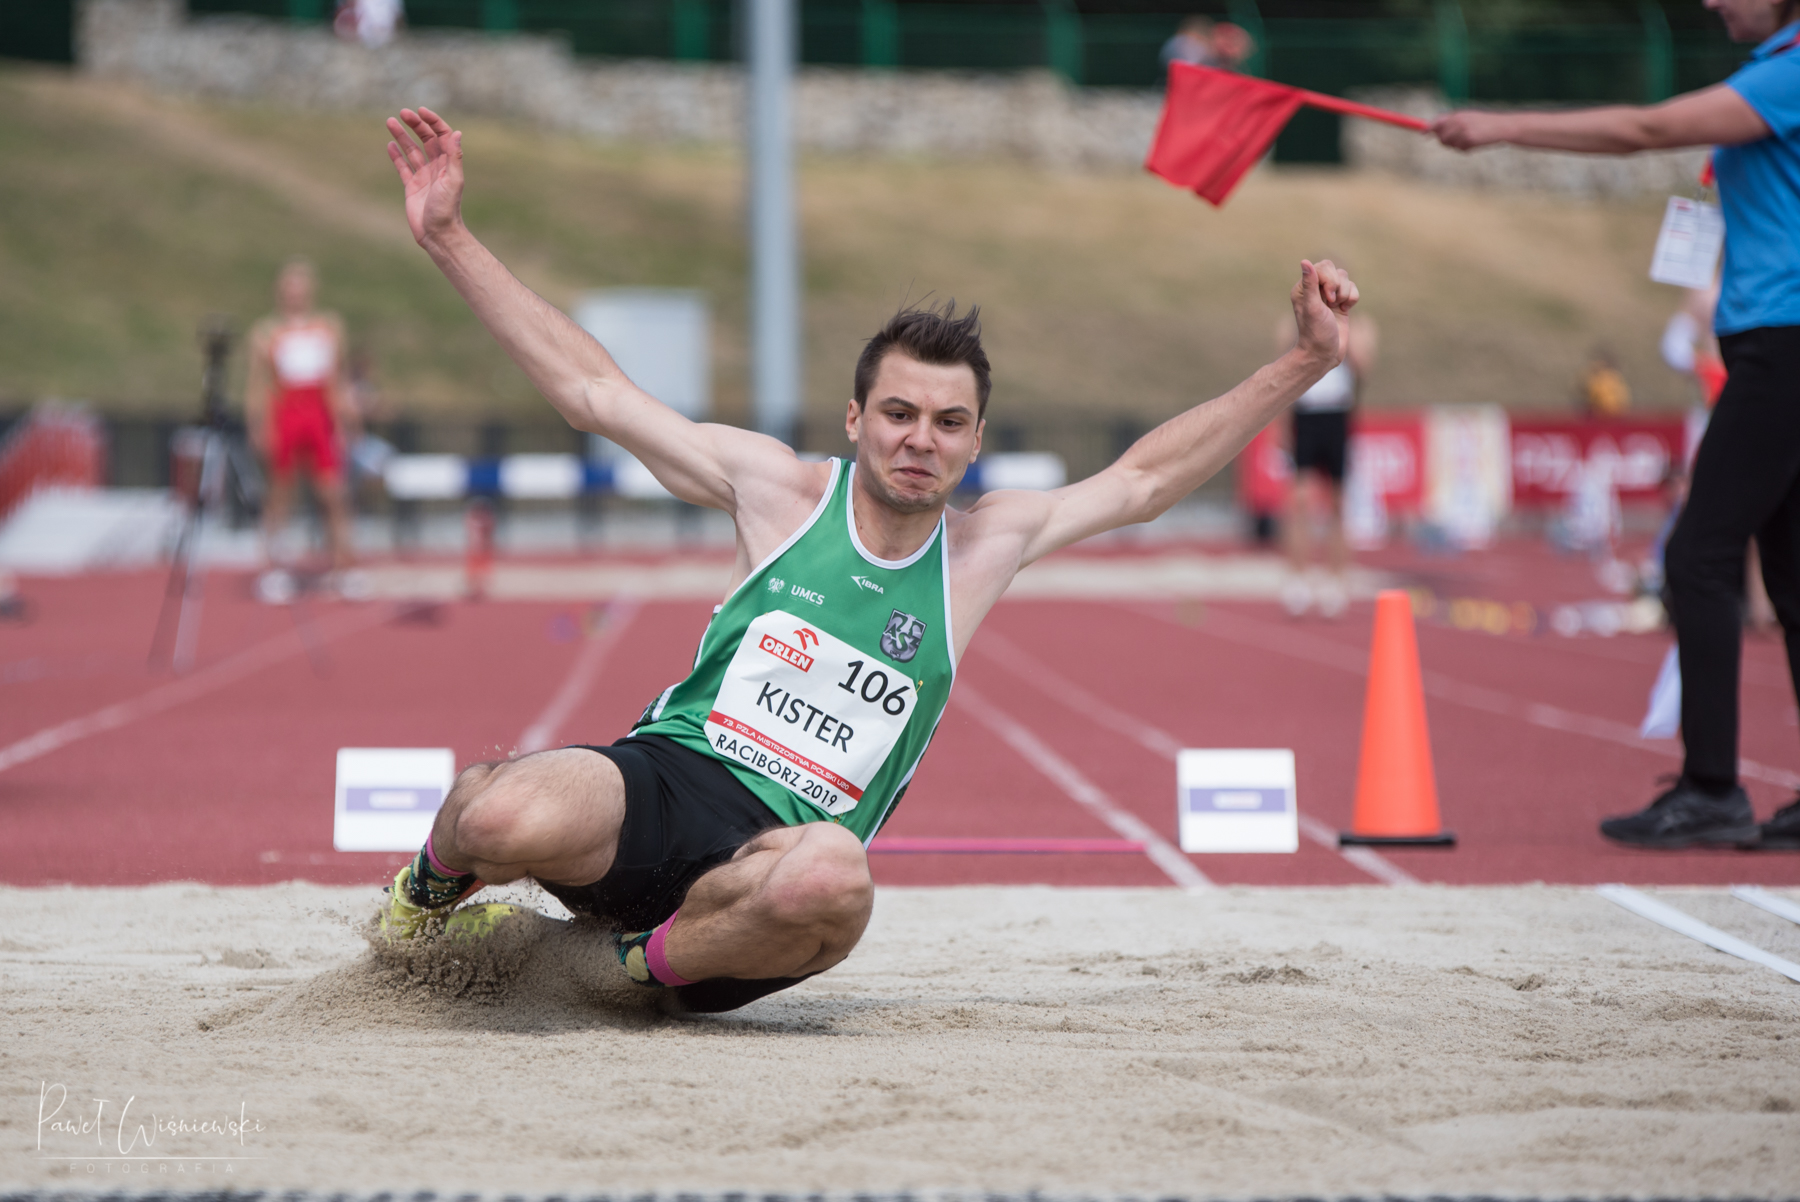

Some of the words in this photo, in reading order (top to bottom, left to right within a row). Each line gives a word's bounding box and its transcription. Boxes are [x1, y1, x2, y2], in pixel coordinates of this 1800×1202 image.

[791, 585, 825, 605] UMCS
[763, 637, 811, 669] ORLEN
[756, 682, 854, 753] KISTER
[838, 660, 910, 716] 106
[716, 734, 801, 787] RACIBÓRZ
[802, 779, 837, 808] 2019
[736, 725, 756, 740] PZLA
[757, 735, 810, 767] MISTRZOSTWA
[811, 764, 837, 783] POLSKI
[837, 779, 849, 790] U20
